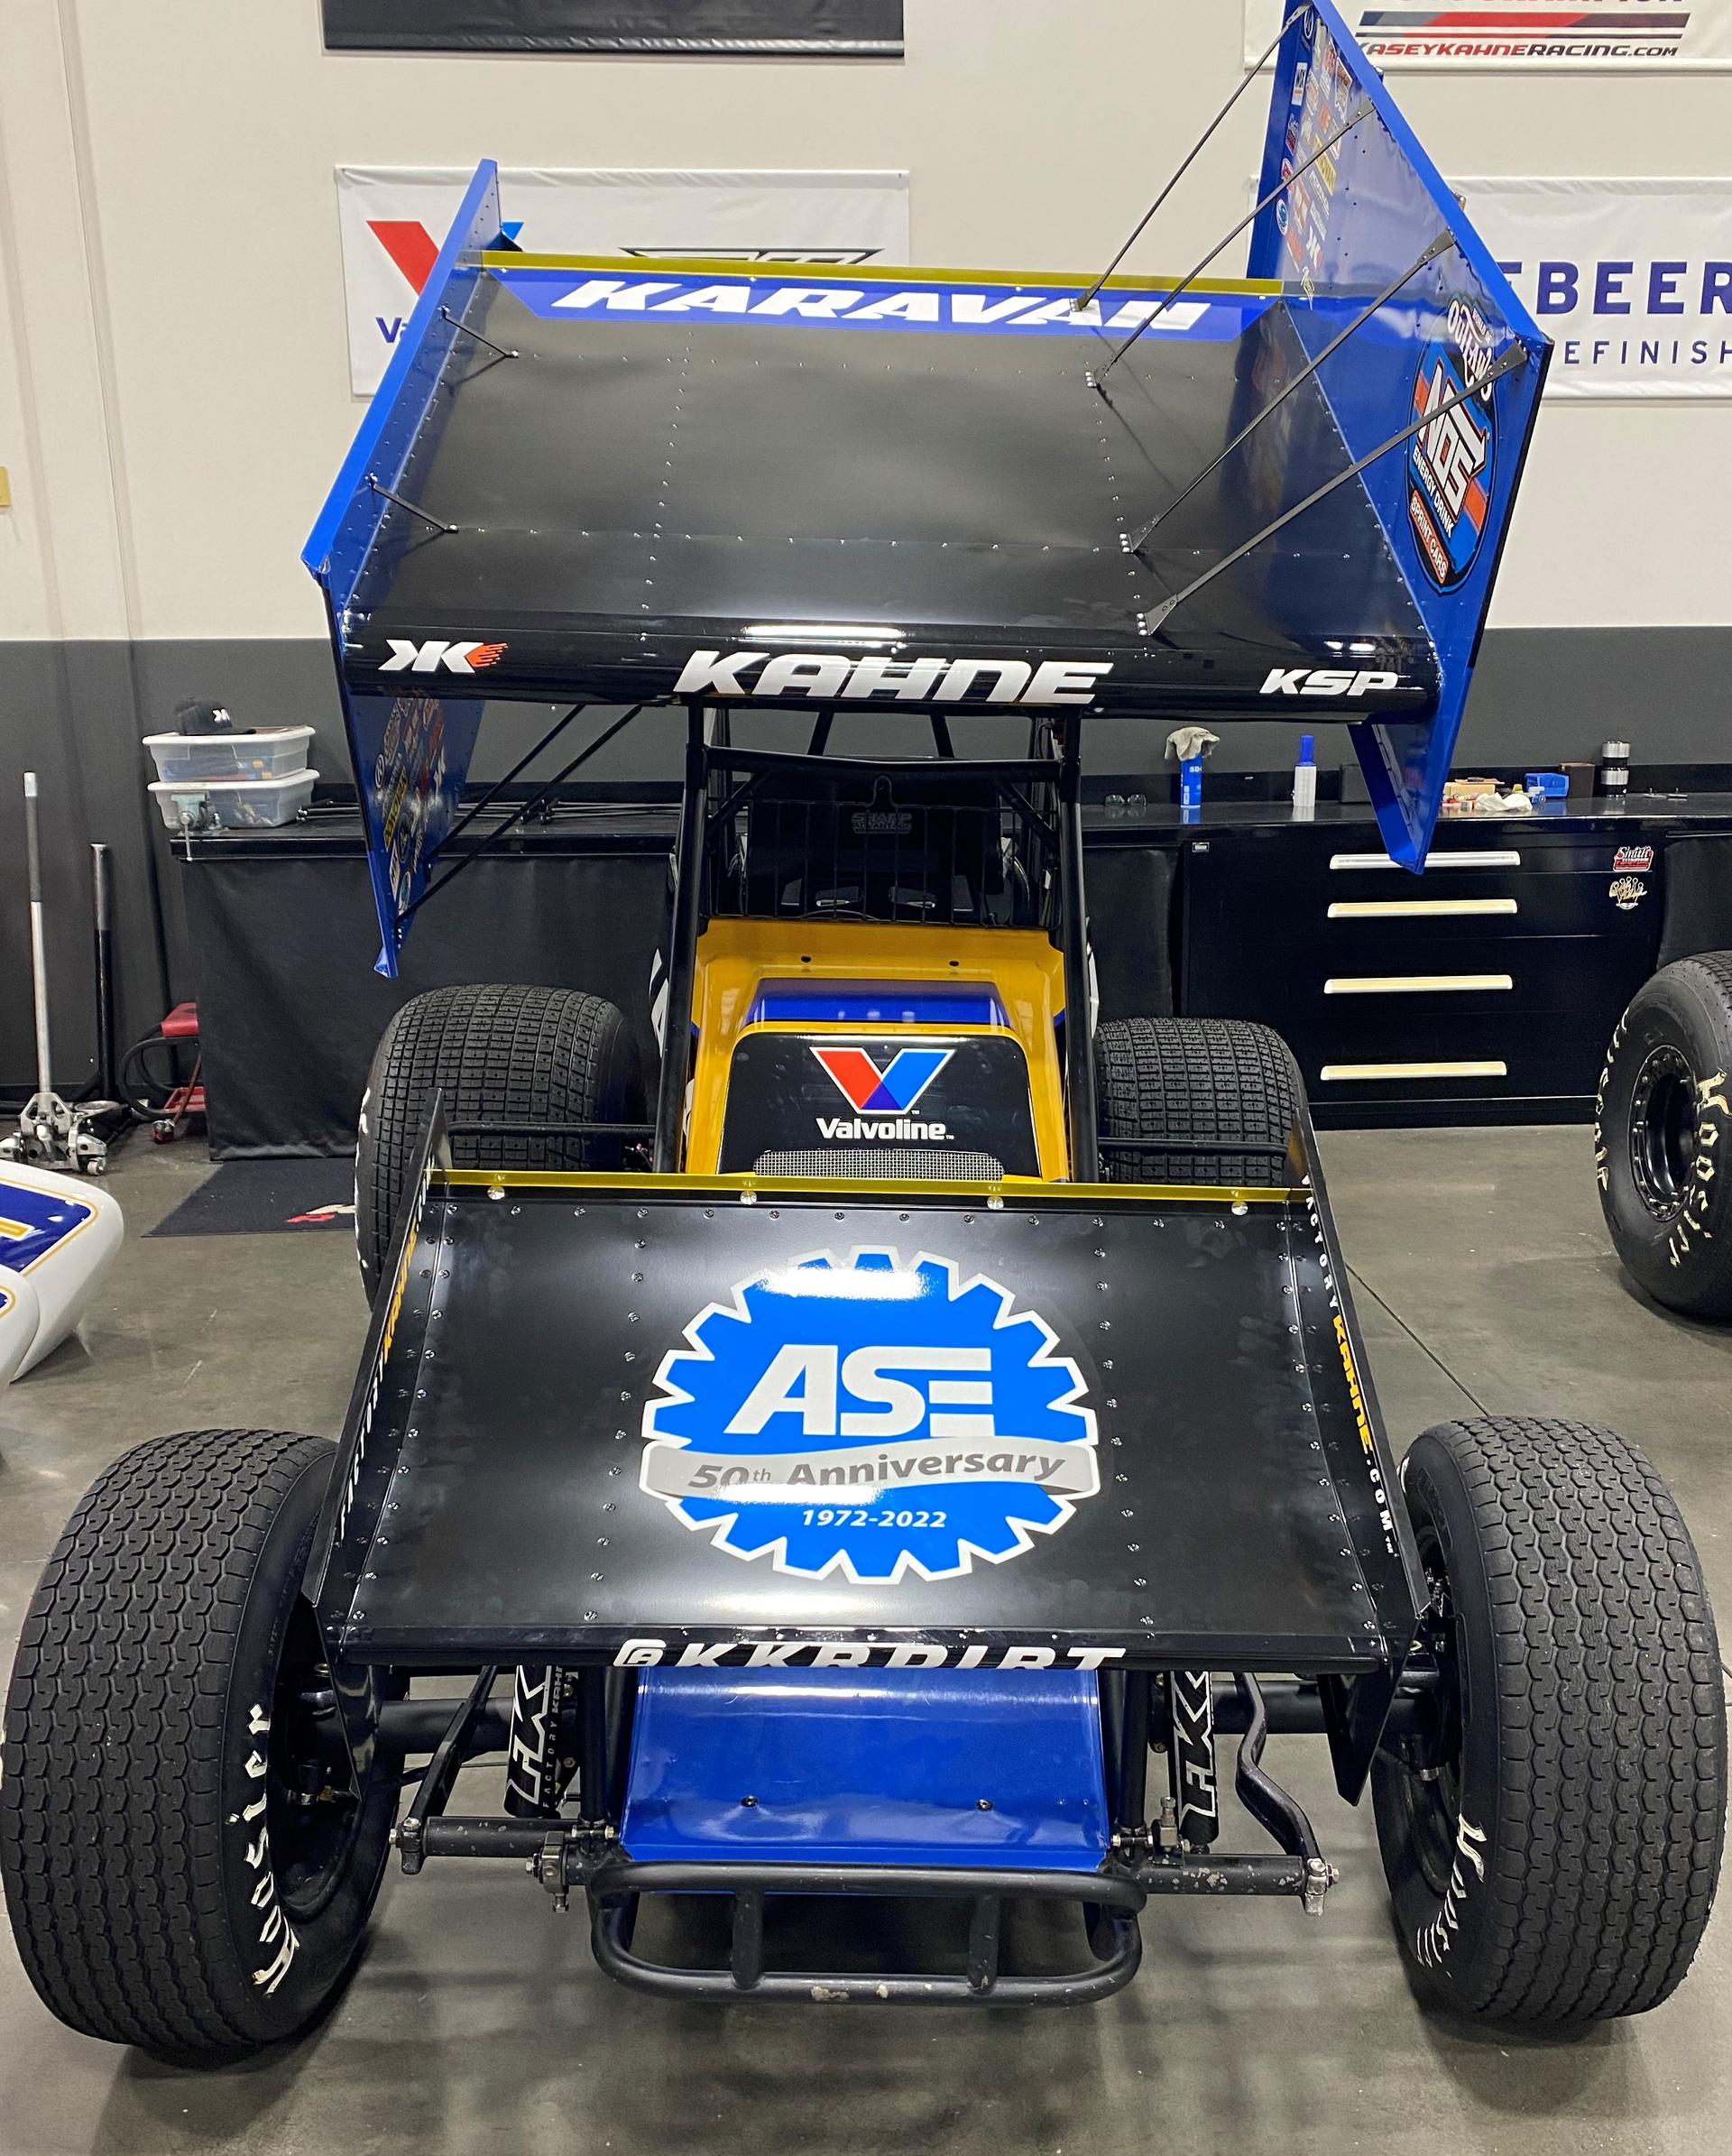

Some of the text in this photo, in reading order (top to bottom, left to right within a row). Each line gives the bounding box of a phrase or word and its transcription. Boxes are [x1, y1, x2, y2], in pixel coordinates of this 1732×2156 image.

[551, 279, 1211, 332] KARAVAN
[1415, 363, 1488, 517] NOS
[1412, 446, 1455, 539] ENERGY DRINK
[1410, 494, 1447, 579] SPRINT CARS
[673, 650, 1114, 705] KAHNE
[1259, 668, 1399, 696] KSP
[815, 1118, 946, 1140] Valvoline
[723, 1344, 994, 1437] ASE
[687, 1453, 1066, 1488] 50th Anniversary
[802, 1509, 947, 1528] 1972-2022
[542, 1720, 557, 1809] FACTORY
